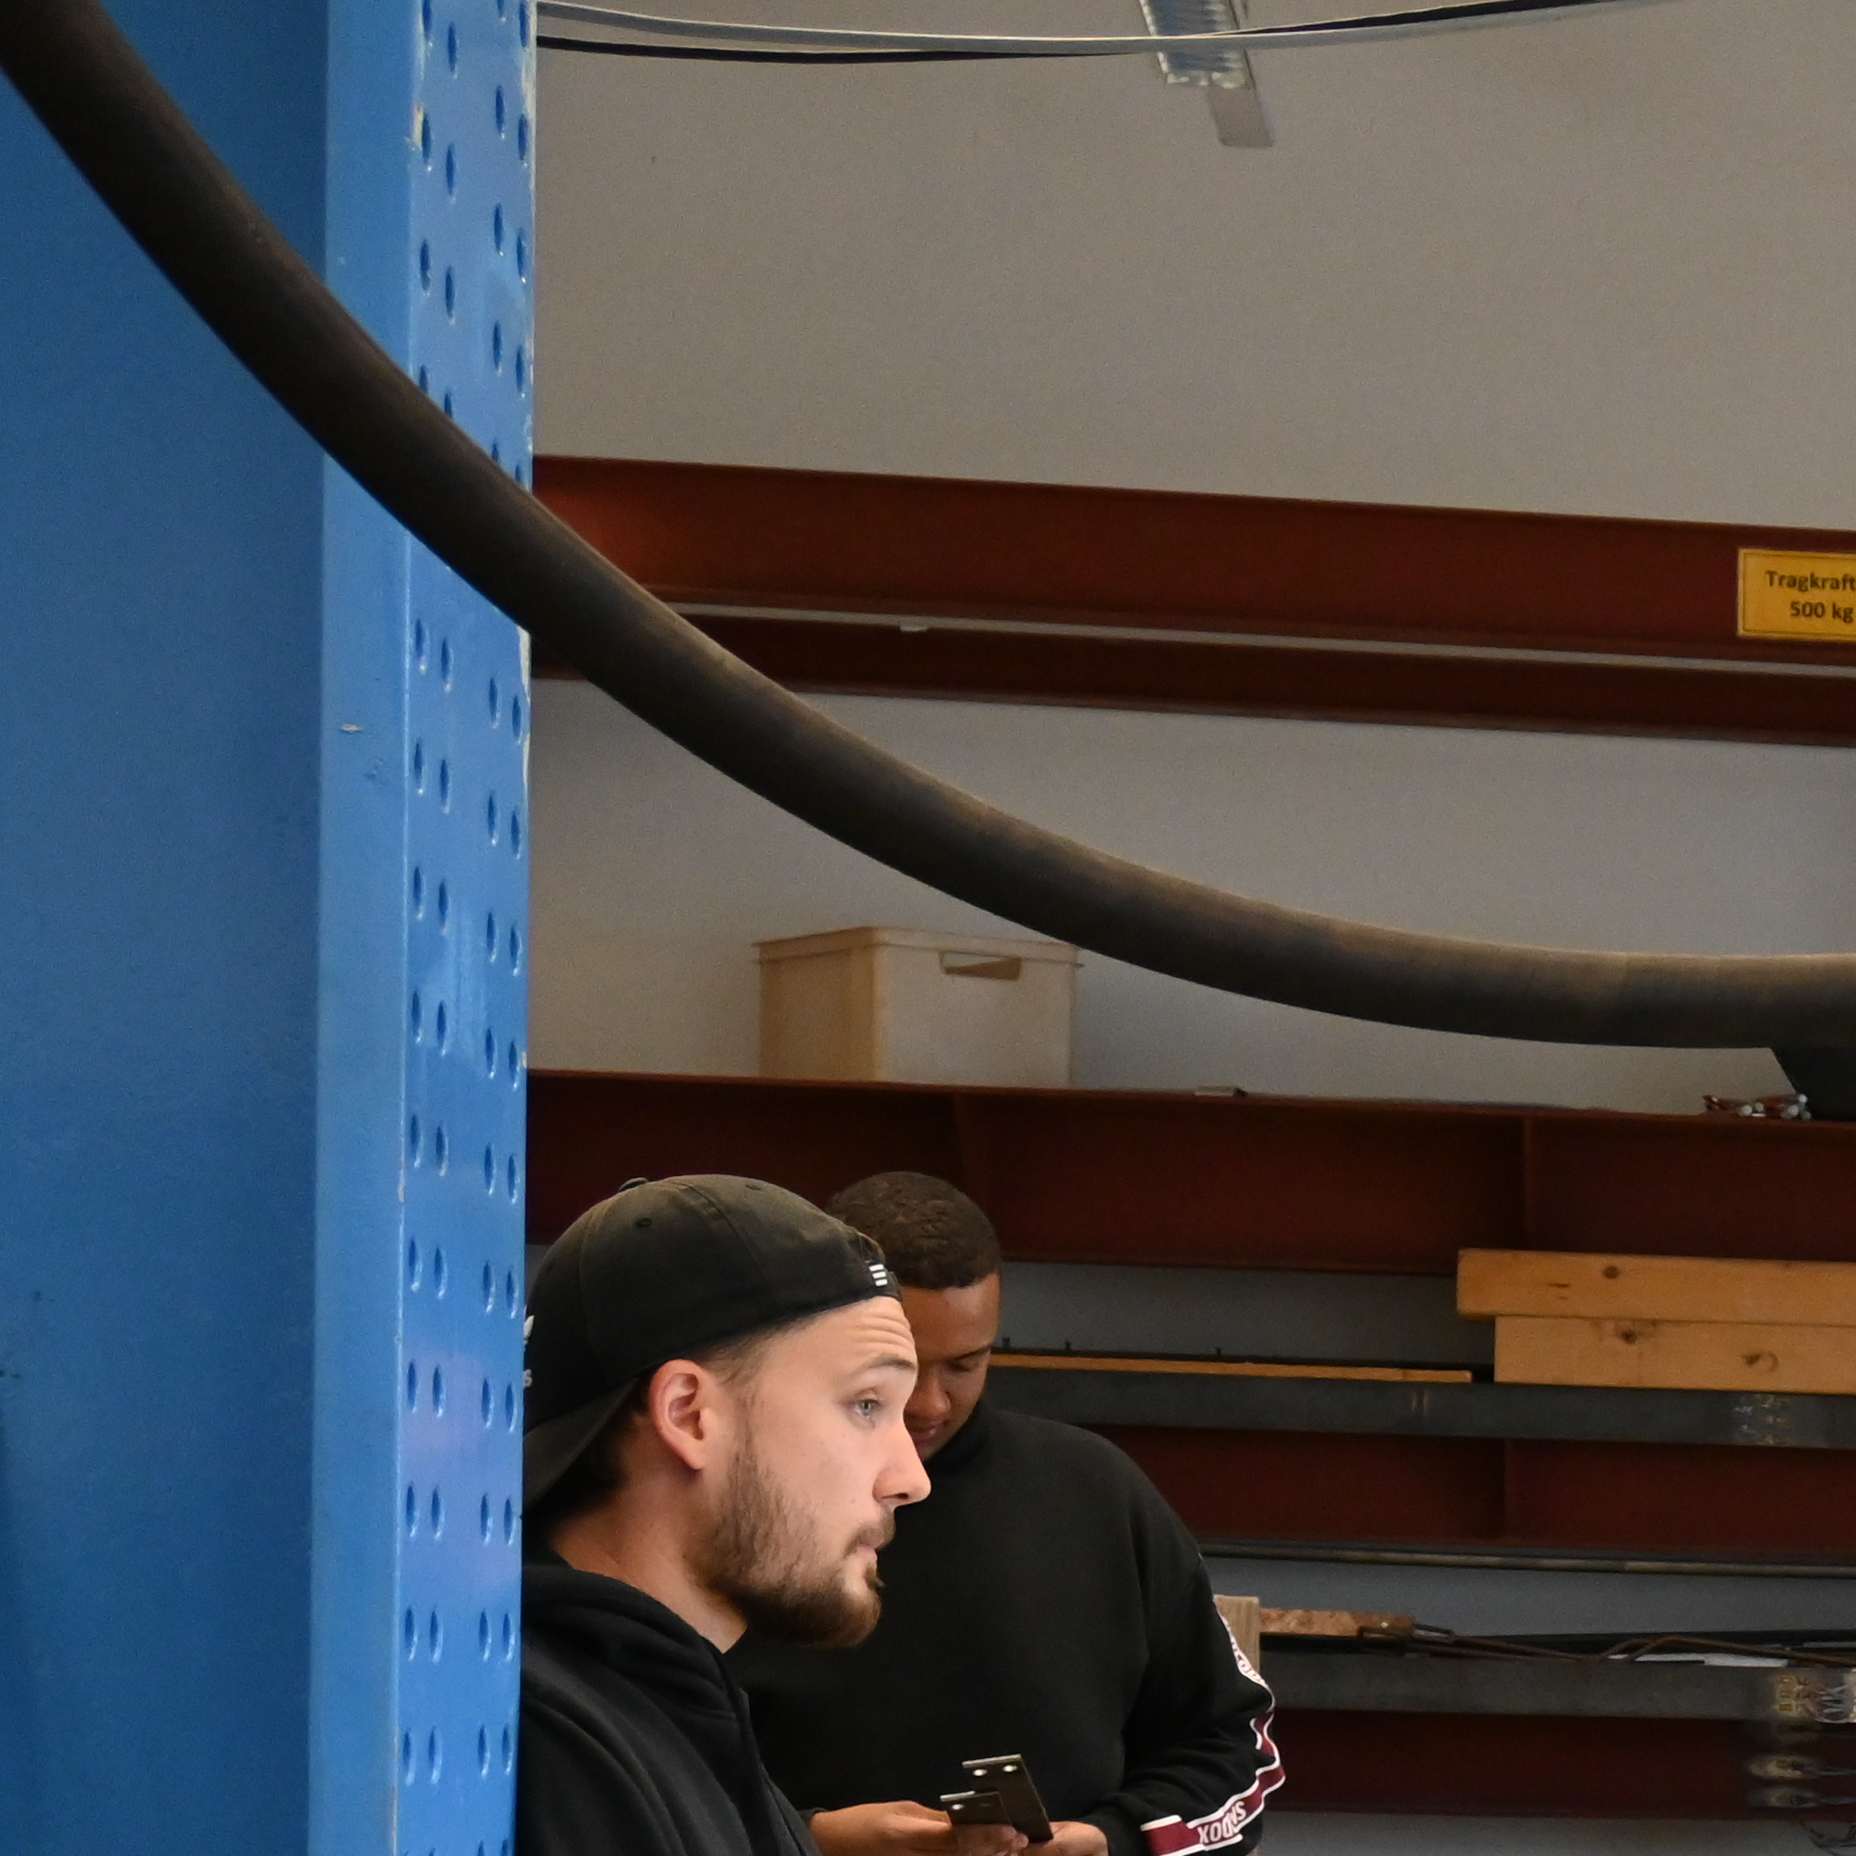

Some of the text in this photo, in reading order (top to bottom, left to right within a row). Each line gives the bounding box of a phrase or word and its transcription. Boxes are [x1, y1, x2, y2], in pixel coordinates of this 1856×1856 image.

[1765, 570, 1856, 592] Tragkraft
[1790, 601, 1854, 623] 500 kg
